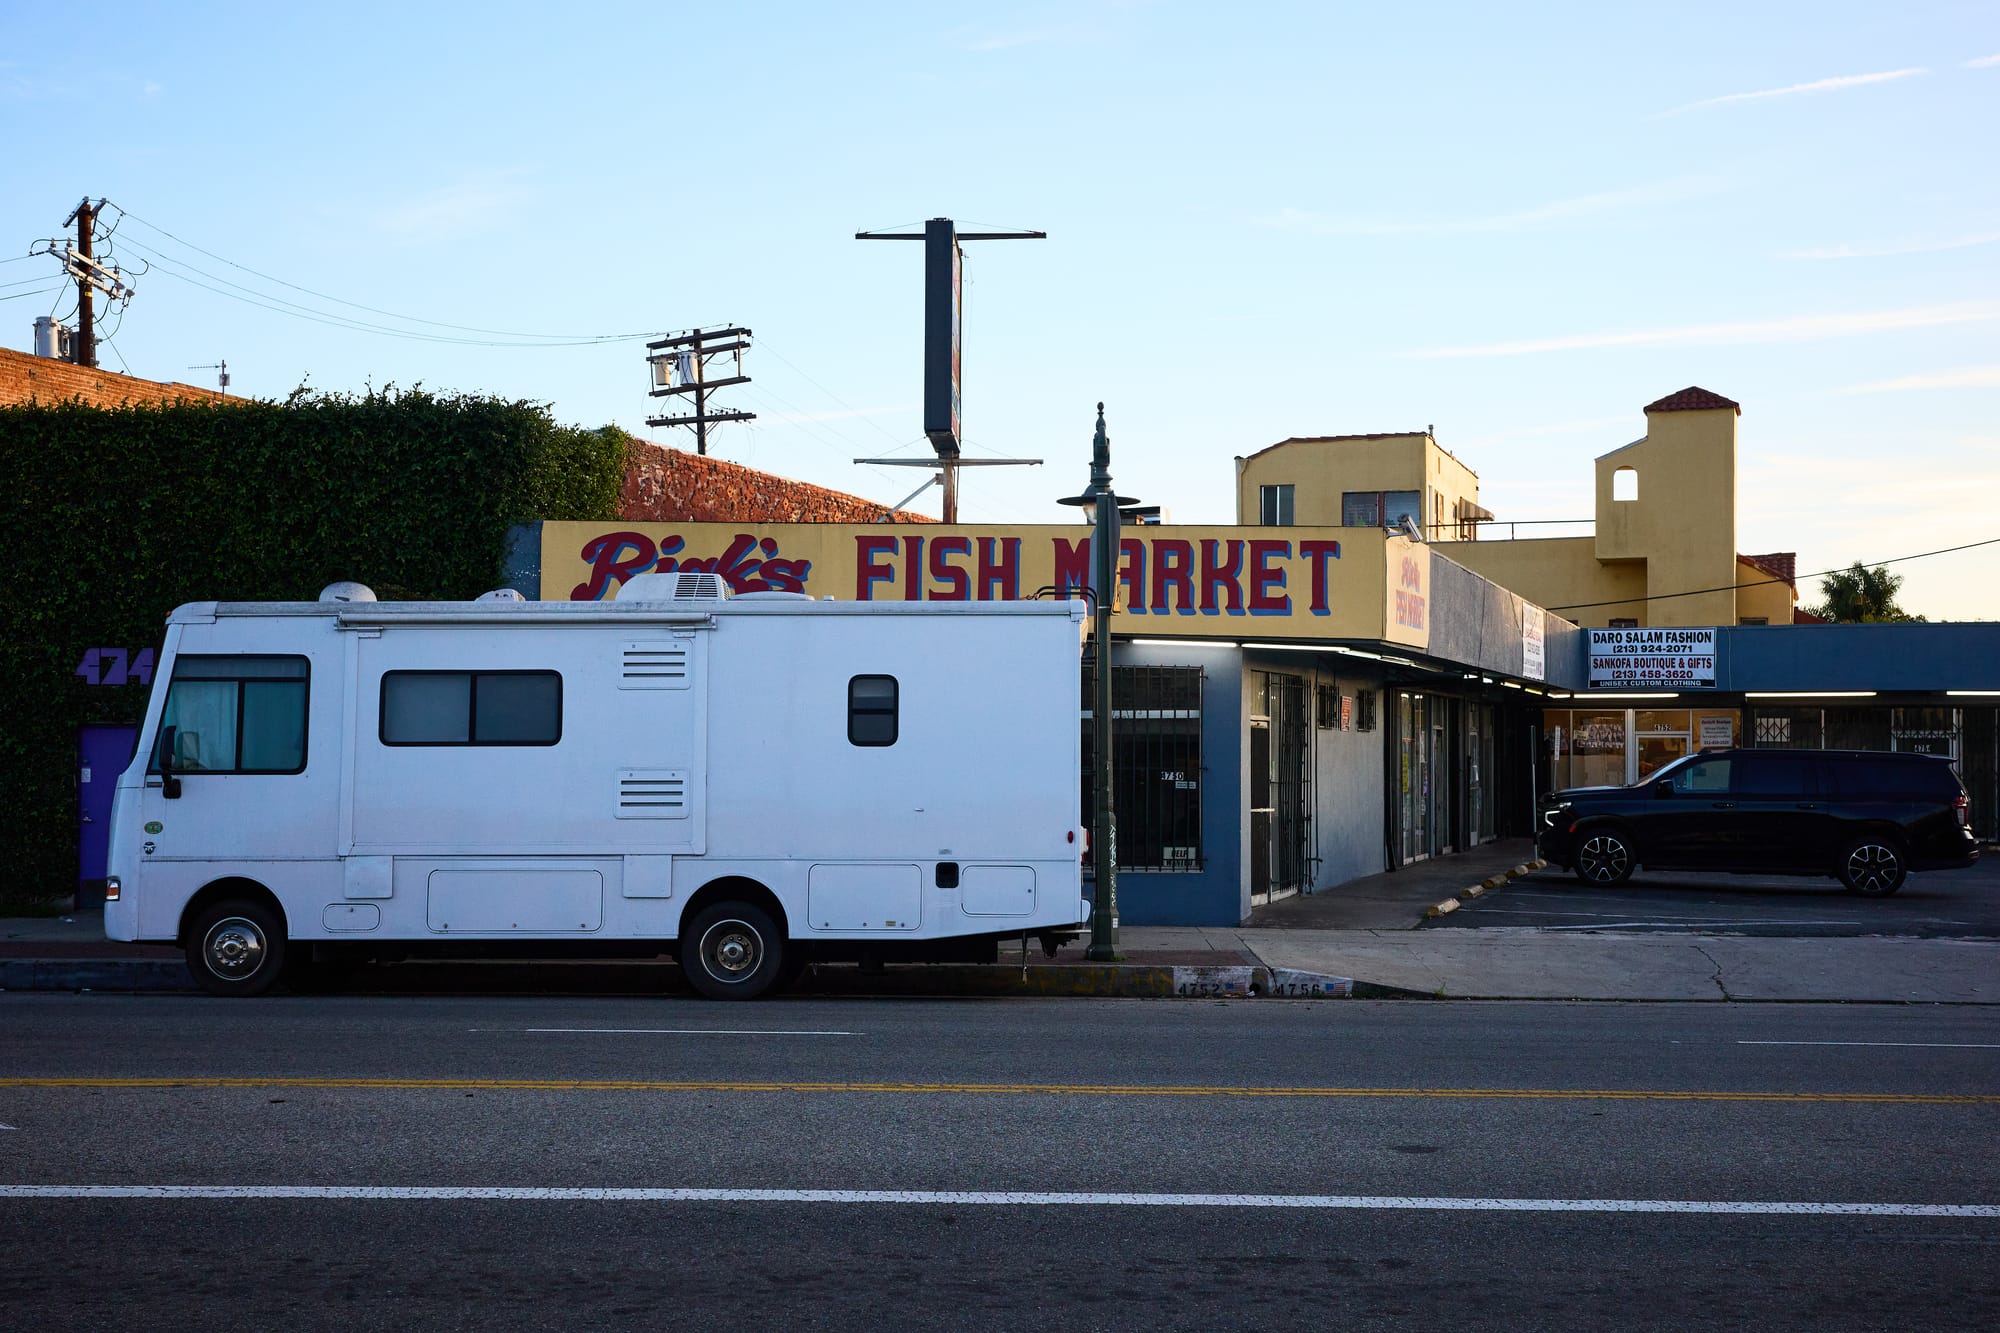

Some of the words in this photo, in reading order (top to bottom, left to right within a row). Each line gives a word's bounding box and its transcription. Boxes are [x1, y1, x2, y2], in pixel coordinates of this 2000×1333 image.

[855, 535, 1022, 600] FISH
[1051, 537, 1341, 616] MARKET
[1593, 632, 1622, 643] DARO
[1626, 632, 1663, 643] SALAM
[1666, 631, 1711, 643] FASHION
[1613, 645, 1638, 653] (213)
[1641, 645, 1692, 653] 924-2071
[72, 648, 154, 685] 474
[1593, 658, 1631, 669] SANKOFA
[1634, 657, 1676, 669] BOUTIQUE
[1678, 658, 1685, 669] &
[1688, 657, 1712, 669] GIFTS
[1612, 670, 1637, 679] (213)
[1640, 670, 1693, 679] 458-3620
